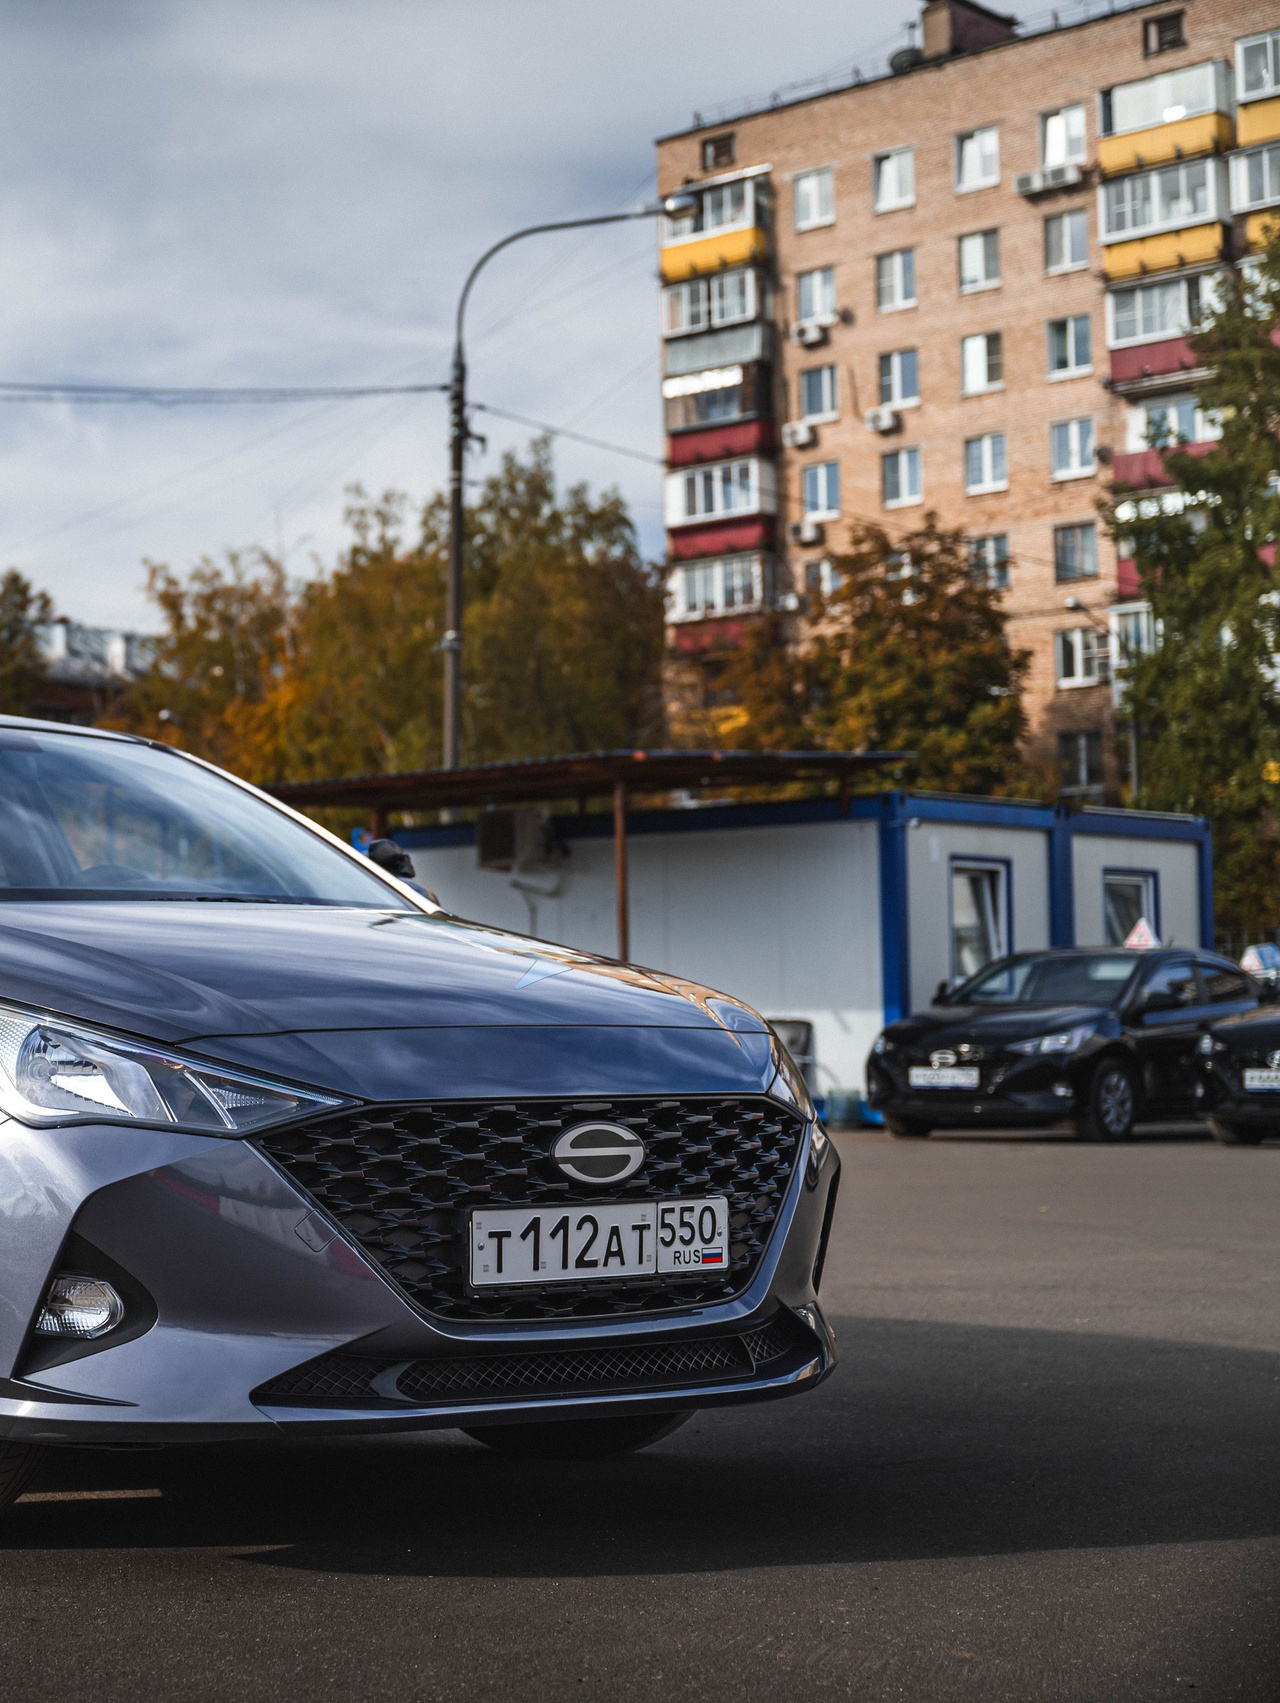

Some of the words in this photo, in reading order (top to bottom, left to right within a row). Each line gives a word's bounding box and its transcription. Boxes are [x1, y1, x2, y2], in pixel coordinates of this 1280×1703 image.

[488, 1214, 652, 1273] Т112АТ
[659, 1205, 717, 1248] 550
[673, 1250, 701, 1265] RUS
